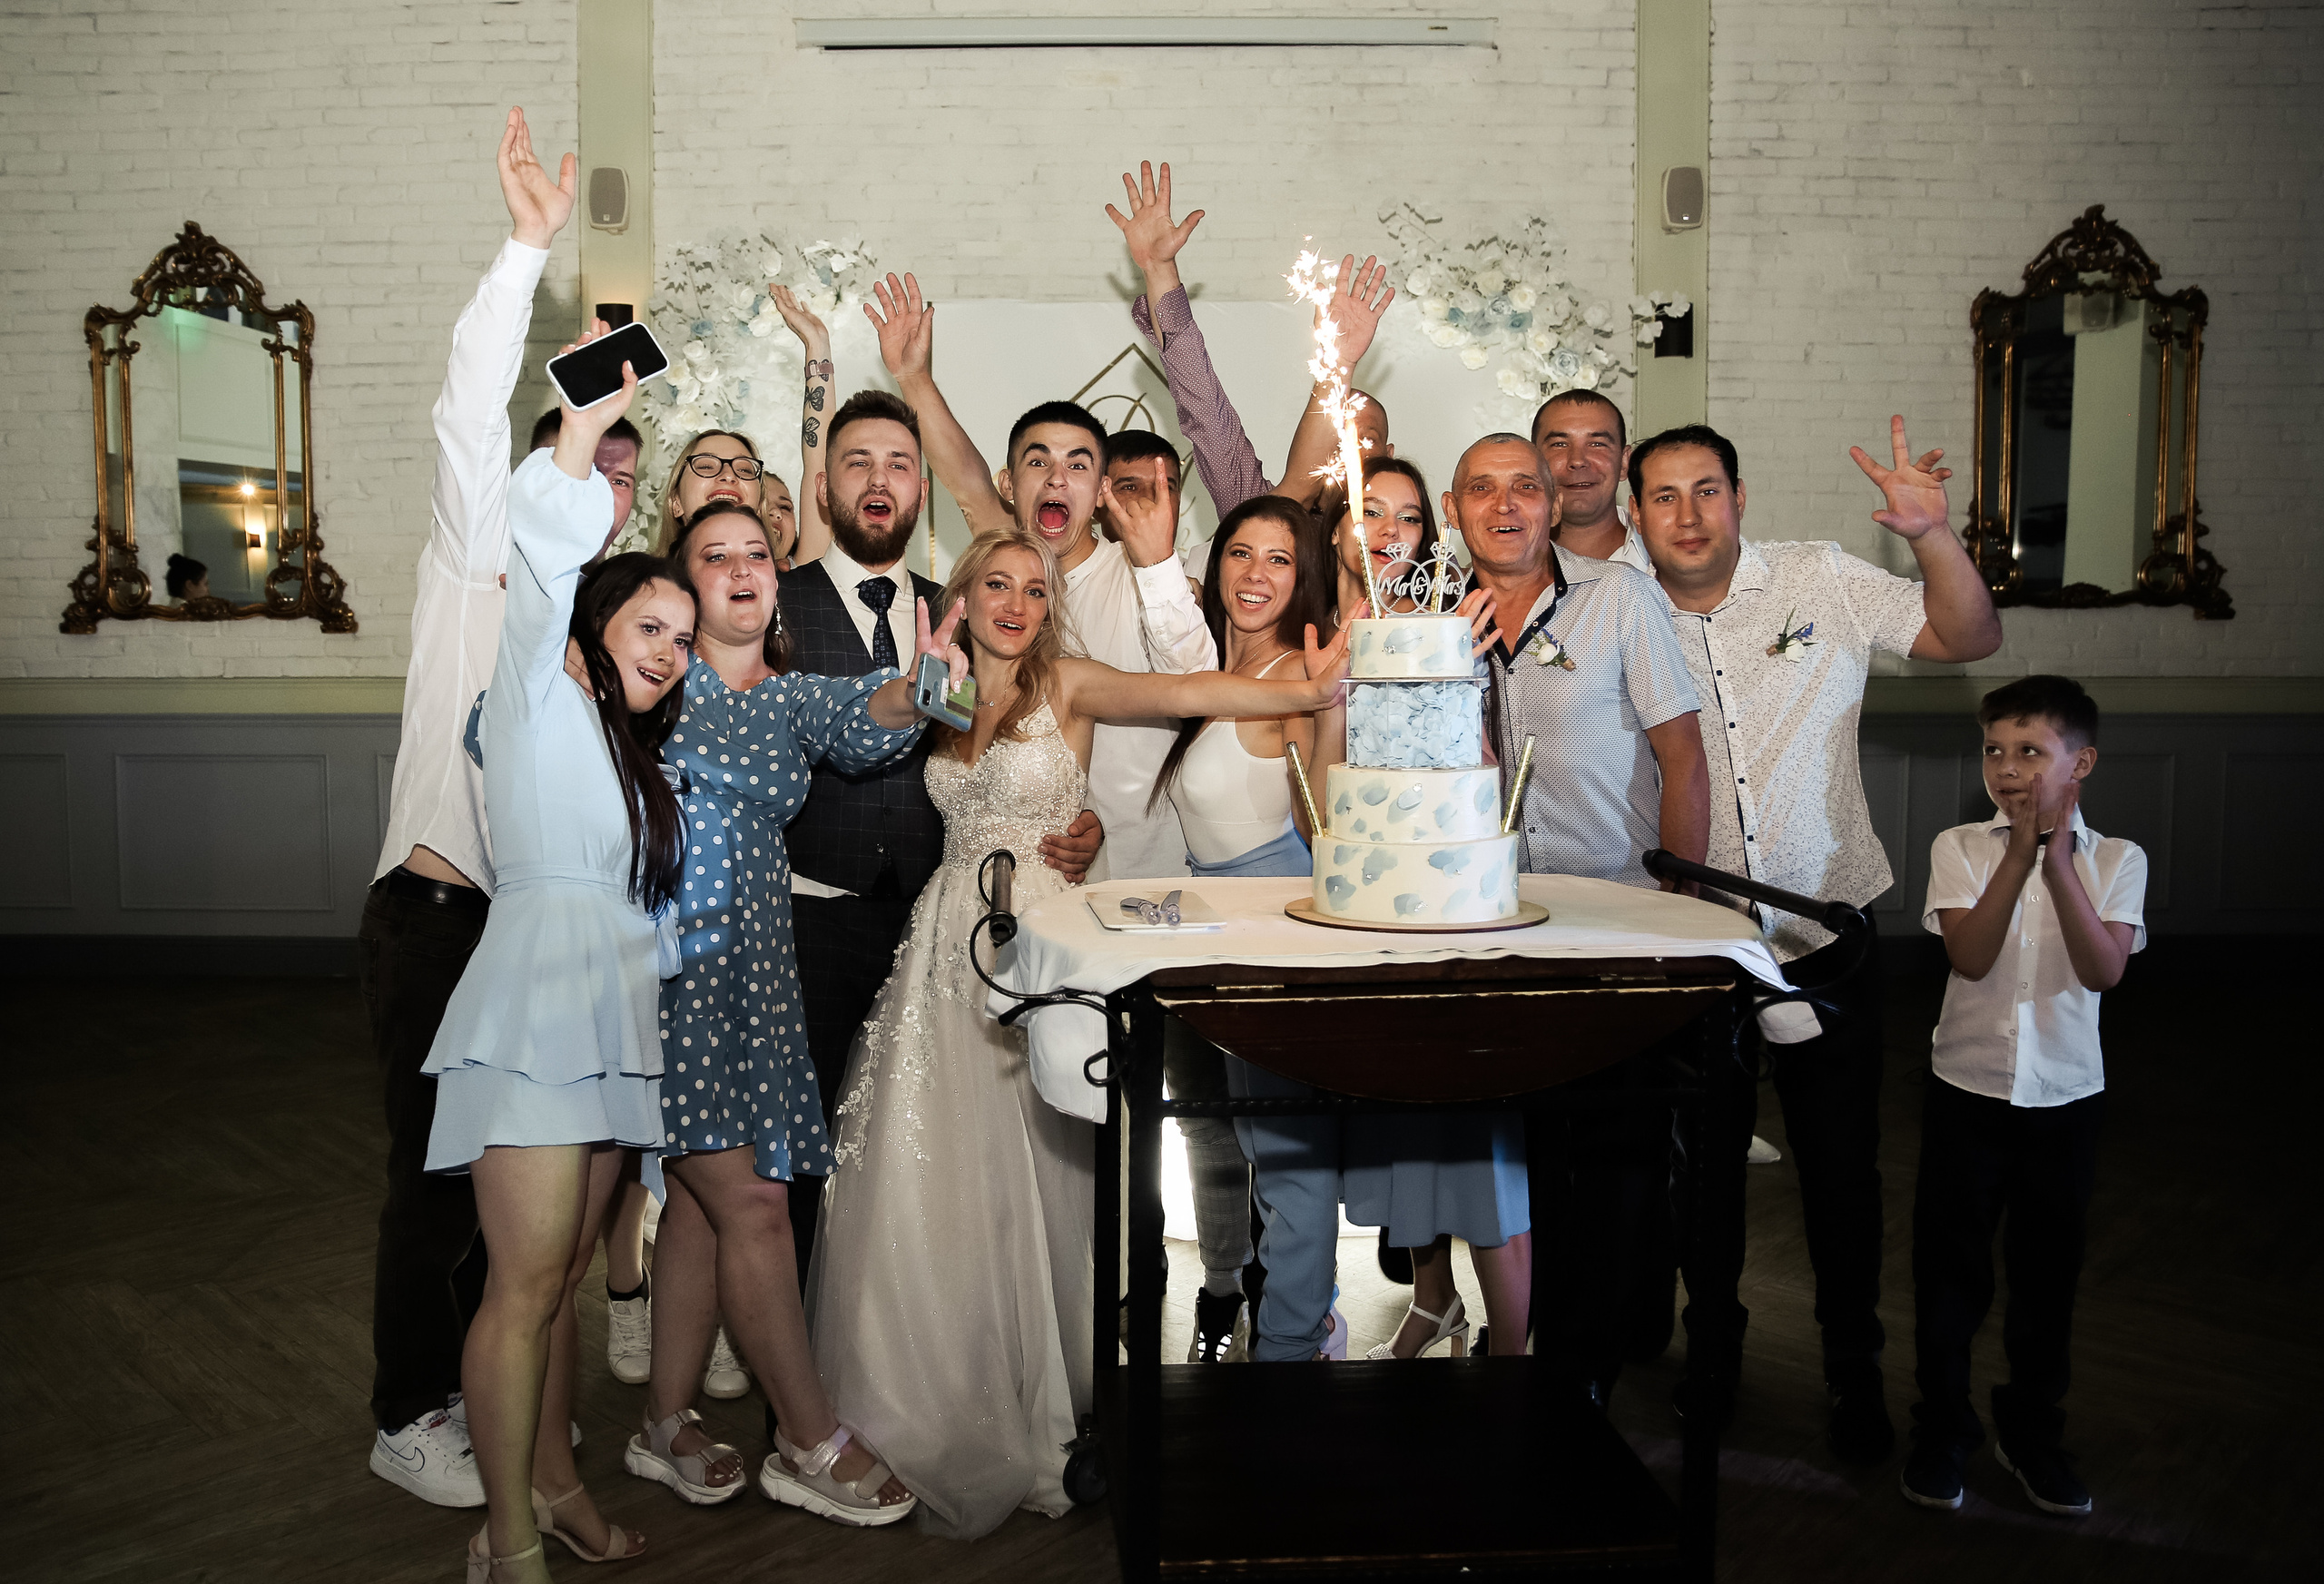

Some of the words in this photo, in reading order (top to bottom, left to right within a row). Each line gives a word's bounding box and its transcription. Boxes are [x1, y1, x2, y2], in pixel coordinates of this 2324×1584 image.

[1379, 575, 1412, 596] Mr
[1413, 576, 1429, 595] &
[1429, 574, 1463, 595] Mrs
